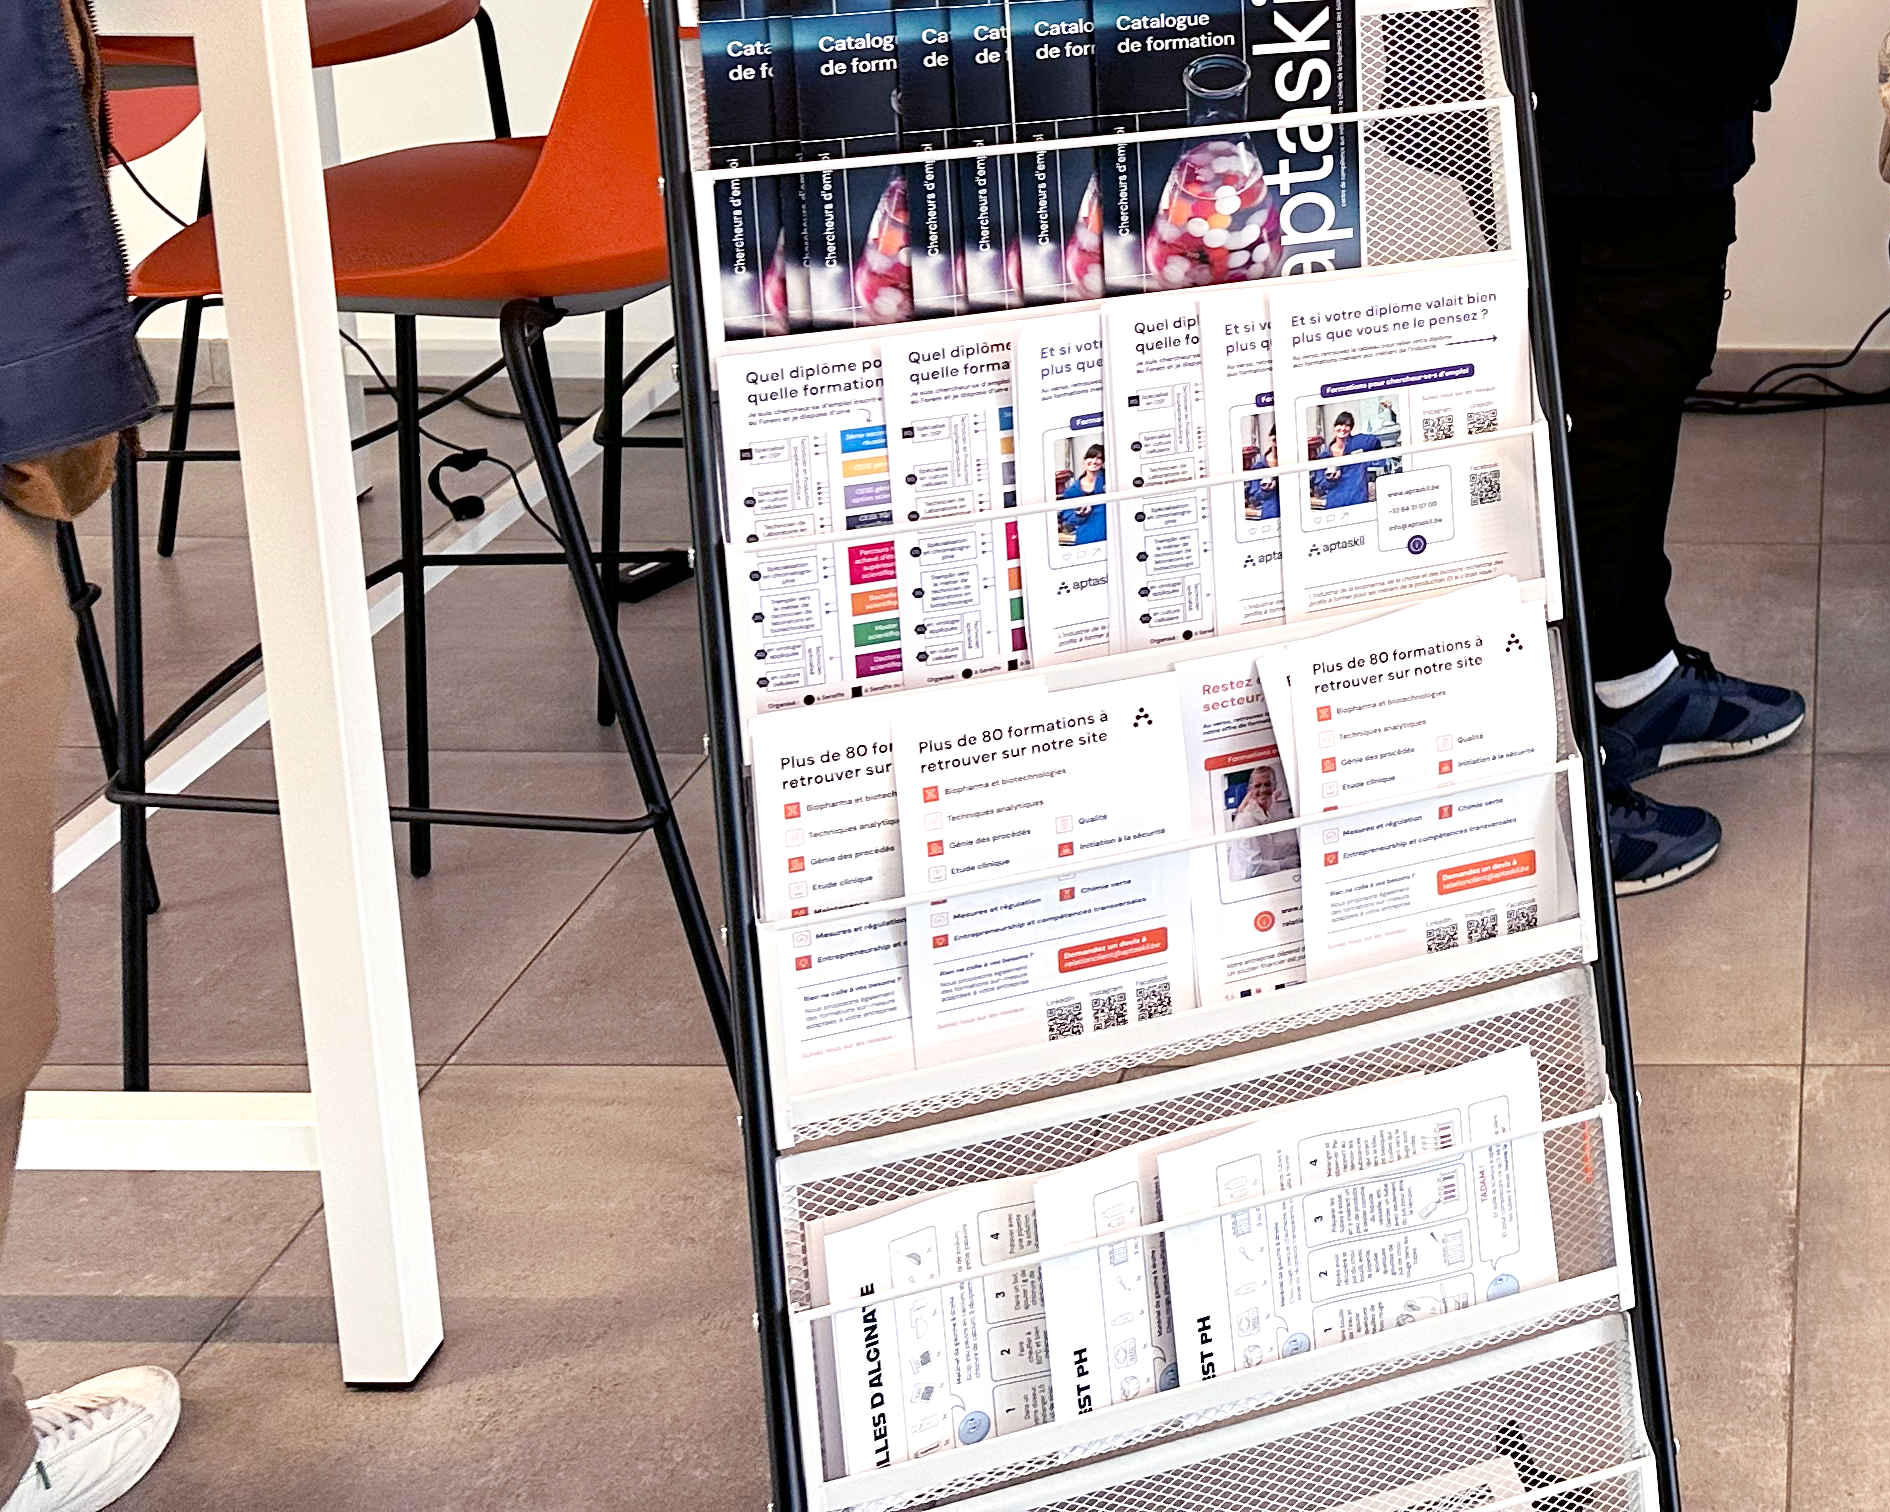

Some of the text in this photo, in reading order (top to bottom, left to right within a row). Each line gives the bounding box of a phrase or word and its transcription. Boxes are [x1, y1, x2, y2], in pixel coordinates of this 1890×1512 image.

[1117, 12, 1210, 32] Catalogue
[1036, 44, 1060, 60] de
[1117, 33, 1236, 54] de formation
[923, 52, 949, 68] de
[975, 48, 1000, 64] de
[729, 64, 755, 81] de
[820, 60, 847, 76] de
[1036, 183, 1050, 245] Chercheurs
[1117, 175, 1130, 236] Chercheurs
[926, 193, 939, 256] Chercheurs
[977, 188, 990, 252] Chercheurs
[732, 210, 747, 274] Chercheurs
[822, 204, 838, 268] Chercheurs
[1292, 291, 1497, 327] Et si votre diplôme valait bien
[1134, 319, 1168, 335] Quel
[1225, 320, 1256, 336] Et si
[1292, 311, 1478, 347] plus que vous ne le pensez
[908, 341, 1012, 365] Quel diplôme
[1040, 346, 1055, 360] Et
[1059, 342, 1072, 355] si
[1135, 338, 1181, 355] quelle
[1225, 341, 1256, 356] plus
[745, 368, 784, 385] Quel
[789, 360, 857, 382] diplôme
[909, 366, 959, 385] quelle
[1041, 357, 1103, 380] plus que
[747, 387, 798, 406] quelle
[1323, 535, 1365, 553] aptaskil
[1312, 635, 1483, 676] Plus de 80 formations à
[1314, 655, 1483, 694] retrouver sur notre site
[1202, 677, 1252, 696] Restez
[919, 709, 1108, 754] Plus de 80 formations à
[780, 756, 815, 770] Plus
[820, 750, 841, 764] de
[846, 745, 868, 758] 80
[920, 731, 1108, 773] retrouver sur notre site
[782, 762, 892, 790] retrouver sur
[1002, 768, 1067, 785] biotechnologies
[947, 808, 994, 823] Techniques
[976, 837, 991, 845] des
[1314, 1215, 1324, 1223] 3
[1197, 1315, 1213, 1345] PH
[1073, 1347, 1089, 1378] PH
